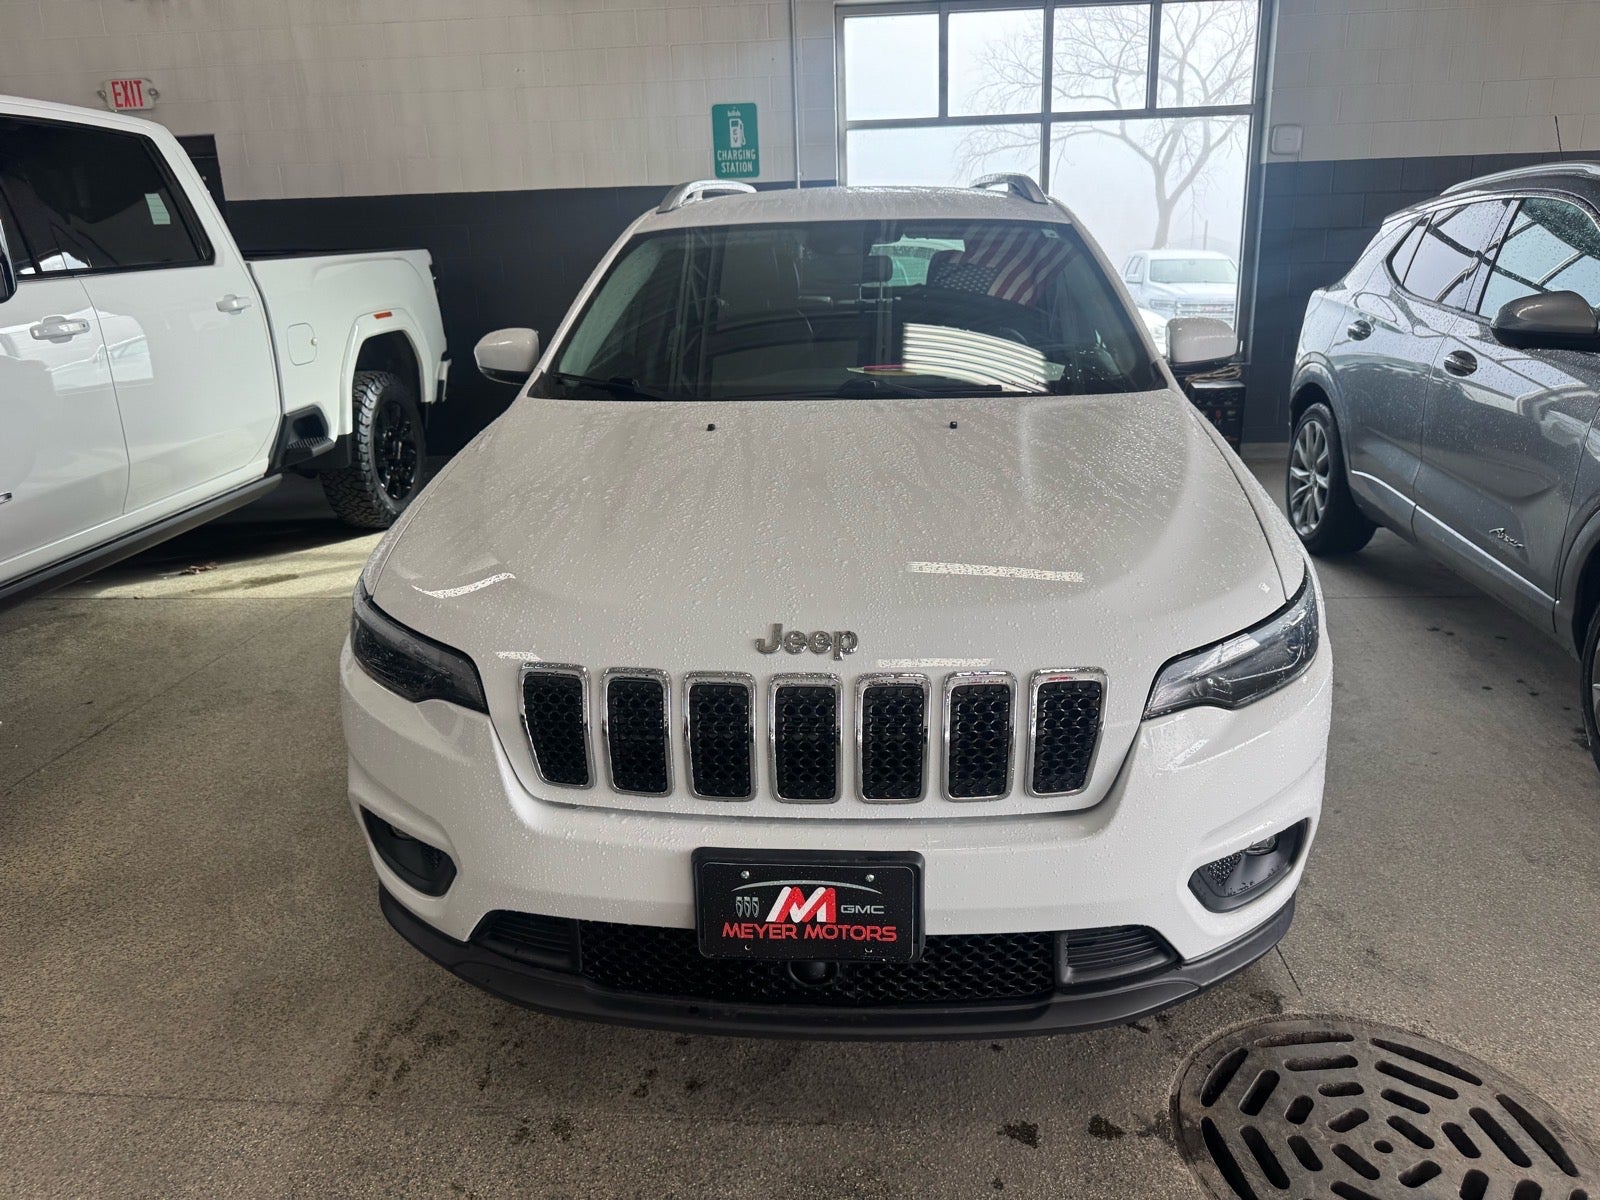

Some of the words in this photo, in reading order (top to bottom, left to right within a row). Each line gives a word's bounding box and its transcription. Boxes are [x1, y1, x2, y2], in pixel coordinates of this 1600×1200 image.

[111, 80, 144, 108] EXIT
[717, 149, 756, 161] CHARGING
[721, 161, 753, 173] STATION
[755, 623, 858, 661] Jeep
[840, 904, 885, 915] GMC
[721, 922, 798, 940] MEYER
[803, 924, 898, 942] MOTORS
